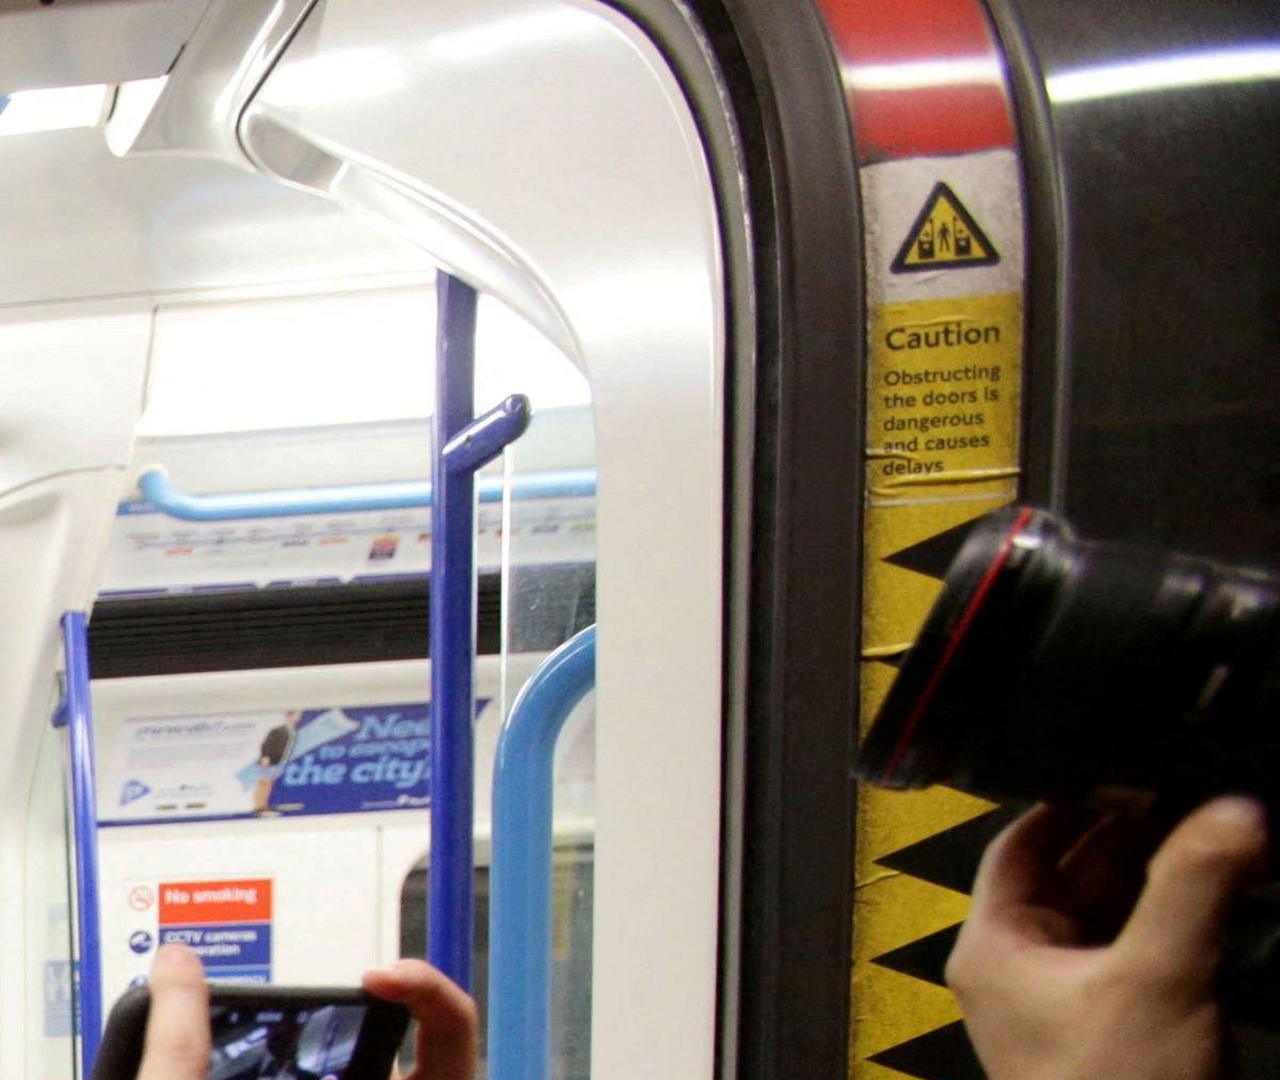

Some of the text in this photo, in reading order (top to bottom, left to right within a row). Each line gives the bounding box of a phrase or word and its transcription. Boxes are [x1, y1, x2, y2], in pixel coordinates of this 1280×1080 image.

[884, 322, 1001, 350] Caution
[884, 365, 1001, 386] Obstructing
[883, 385, 999, 409] the doors is
[883, 411, 985, 434] dangerous
[883, 434, 990, 453] and causes
[882, 459, 944, 477] delays
[355, 713, 431, 741] Nee
[283, 755, 348, 787] the
[164, 887, 258, 905] No smoking
[163, 929, 203, 944] CCTV
